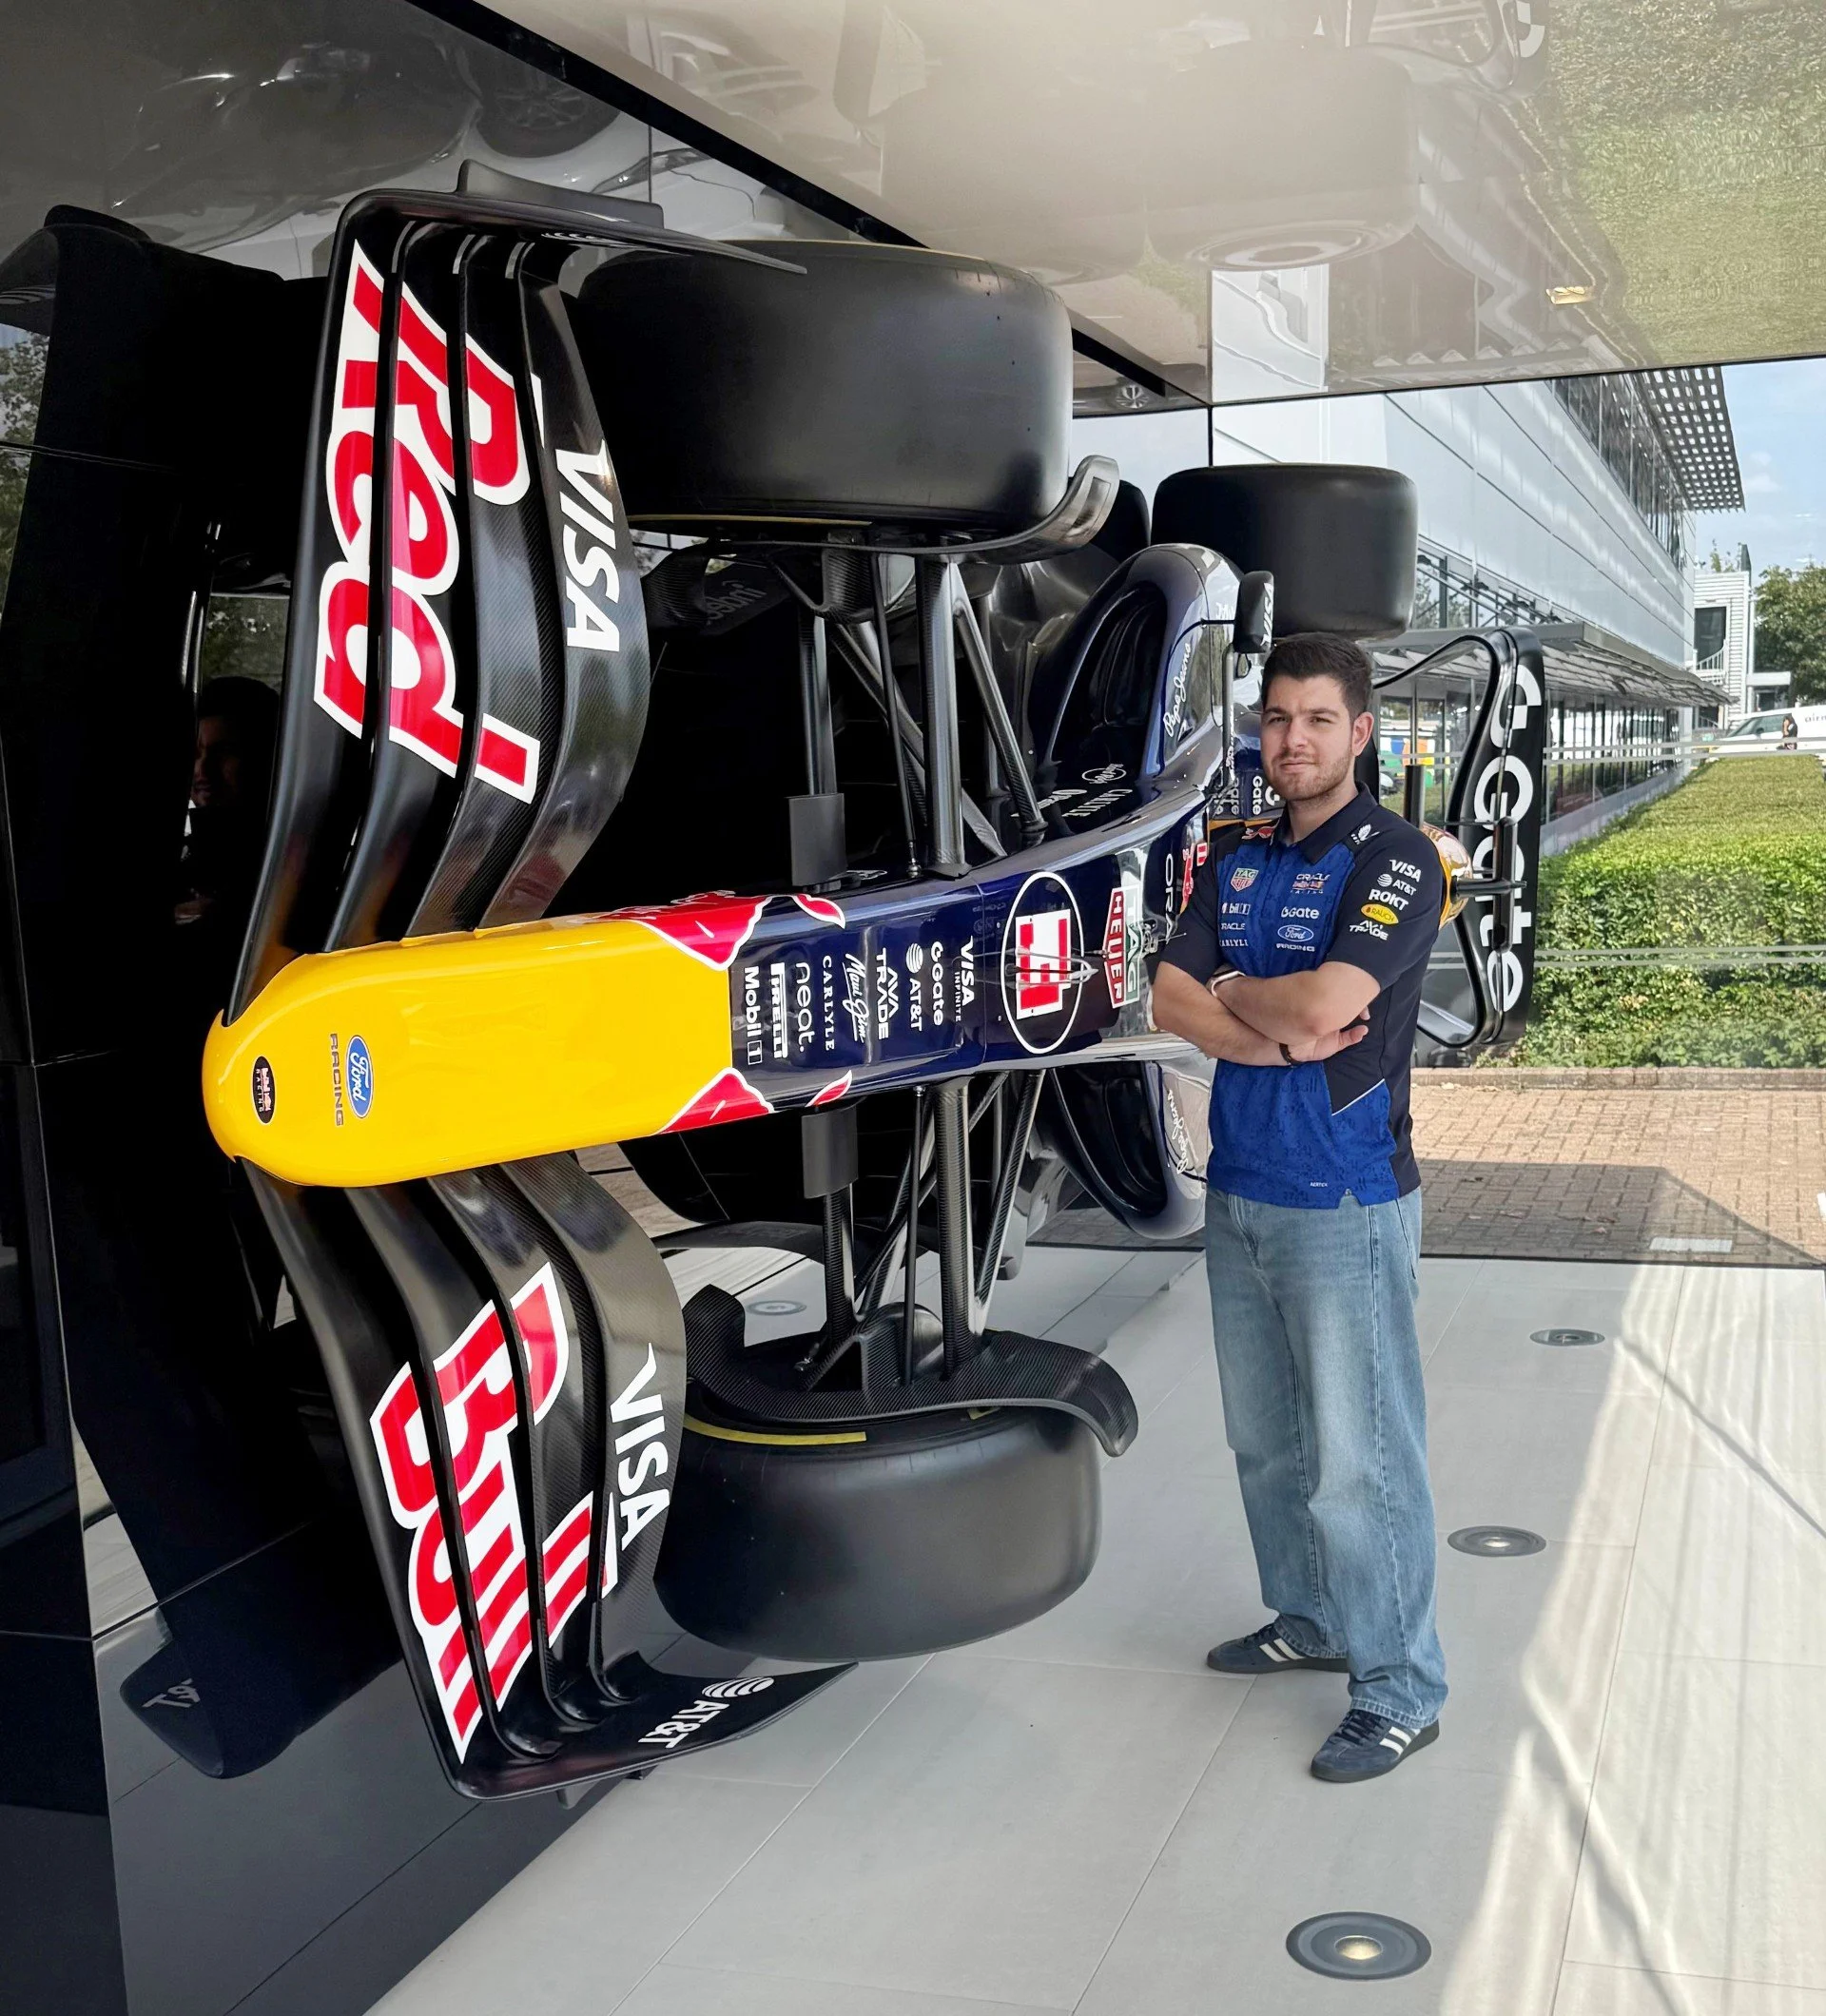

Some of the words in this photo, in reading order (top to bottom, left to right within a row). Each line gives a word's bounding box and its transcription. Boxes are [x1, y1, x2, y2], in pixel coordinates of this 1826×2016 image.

[314, 239, 548, 805] Red
[555, 436, 621, 652] VISA
[1253, 775, 1263, 816] Gate
[1165, 853, 1175, 945] ORA
[1368, 888, 1409, 911] ROKT
[1389, 859, 1422, 882] VISA
[1392, 879, 1418, 897] AT&T
[1221, 922, 1246, 931] RACLE
[1285, 927, 1307, 940] Ford
[1370, 906, 1395, 922] RAUCH
[845, 953, 866, 998] Maui
[961, 935, 975, 1007] VISA
[1108, 896, 1123, 999] HEUER
[744, 965, 762, 1037] Mobil
[770, 962, 788, 1059] PIRELLI
[823, 955, 835, 1052] CARLYLE
[843, 998, 870, 1044] Jim
[876, 947, 889, 1040] TRADE
[909, 978, 923, 1032] AT&T
[931, 962, 944, 1026] Gate
[330, 1033, 344, 1127] RACING
[350, 1052, 371, 1102] Ford
[610, 1343, 670, 1552] VISA
[369, 1261, 619, 1765] Bull
[637, 1698, 731, 1749] AT&T
